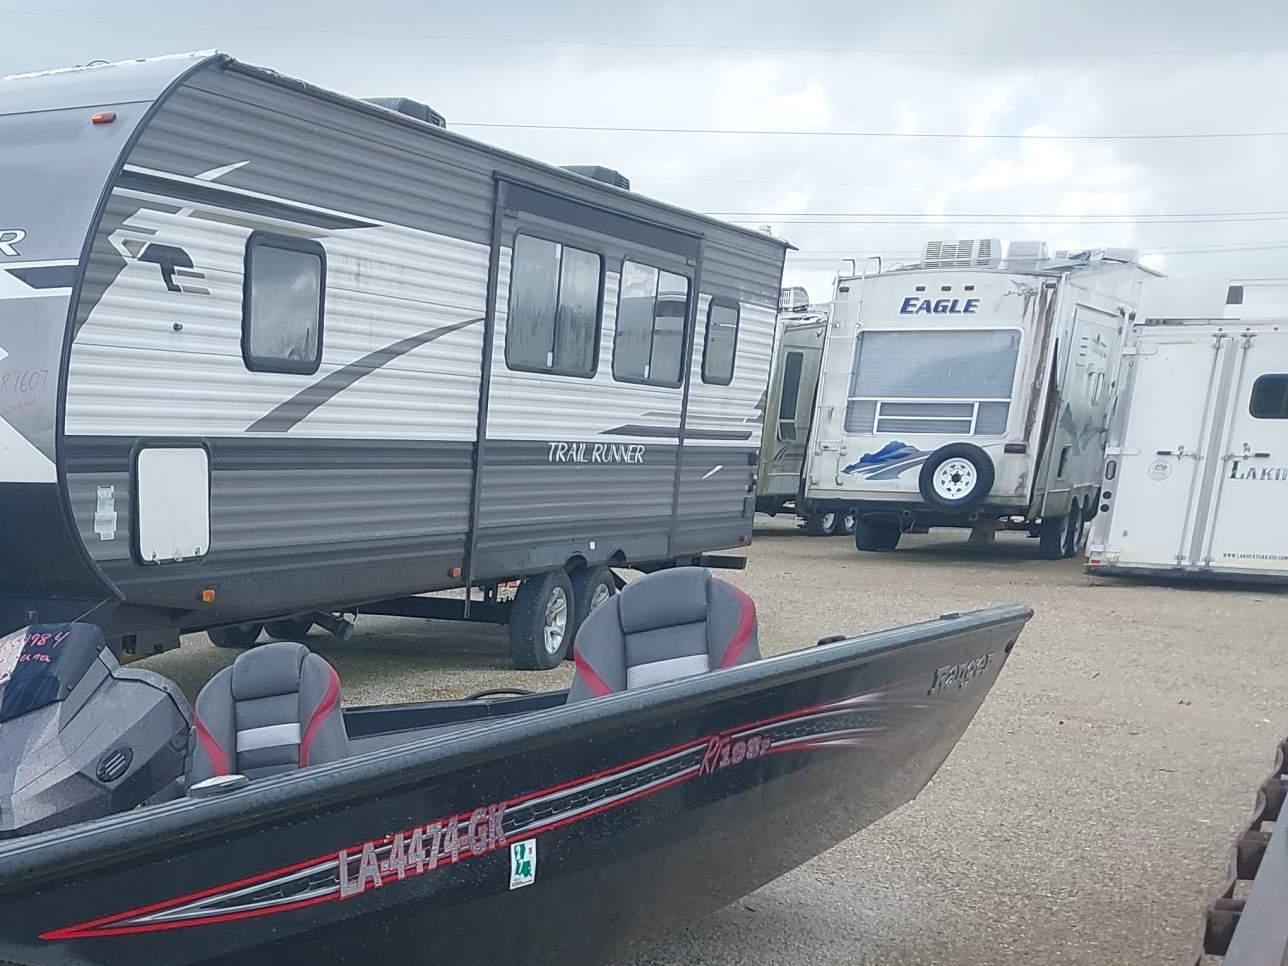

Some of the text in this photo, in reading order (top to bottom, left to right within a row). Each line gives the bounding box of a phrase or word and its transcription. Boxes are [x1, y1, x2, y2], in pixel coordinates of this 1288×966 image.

[899, 296, 981, 315] EAGLE
[548, 442, 646, 464] TRAIL RUNNER
